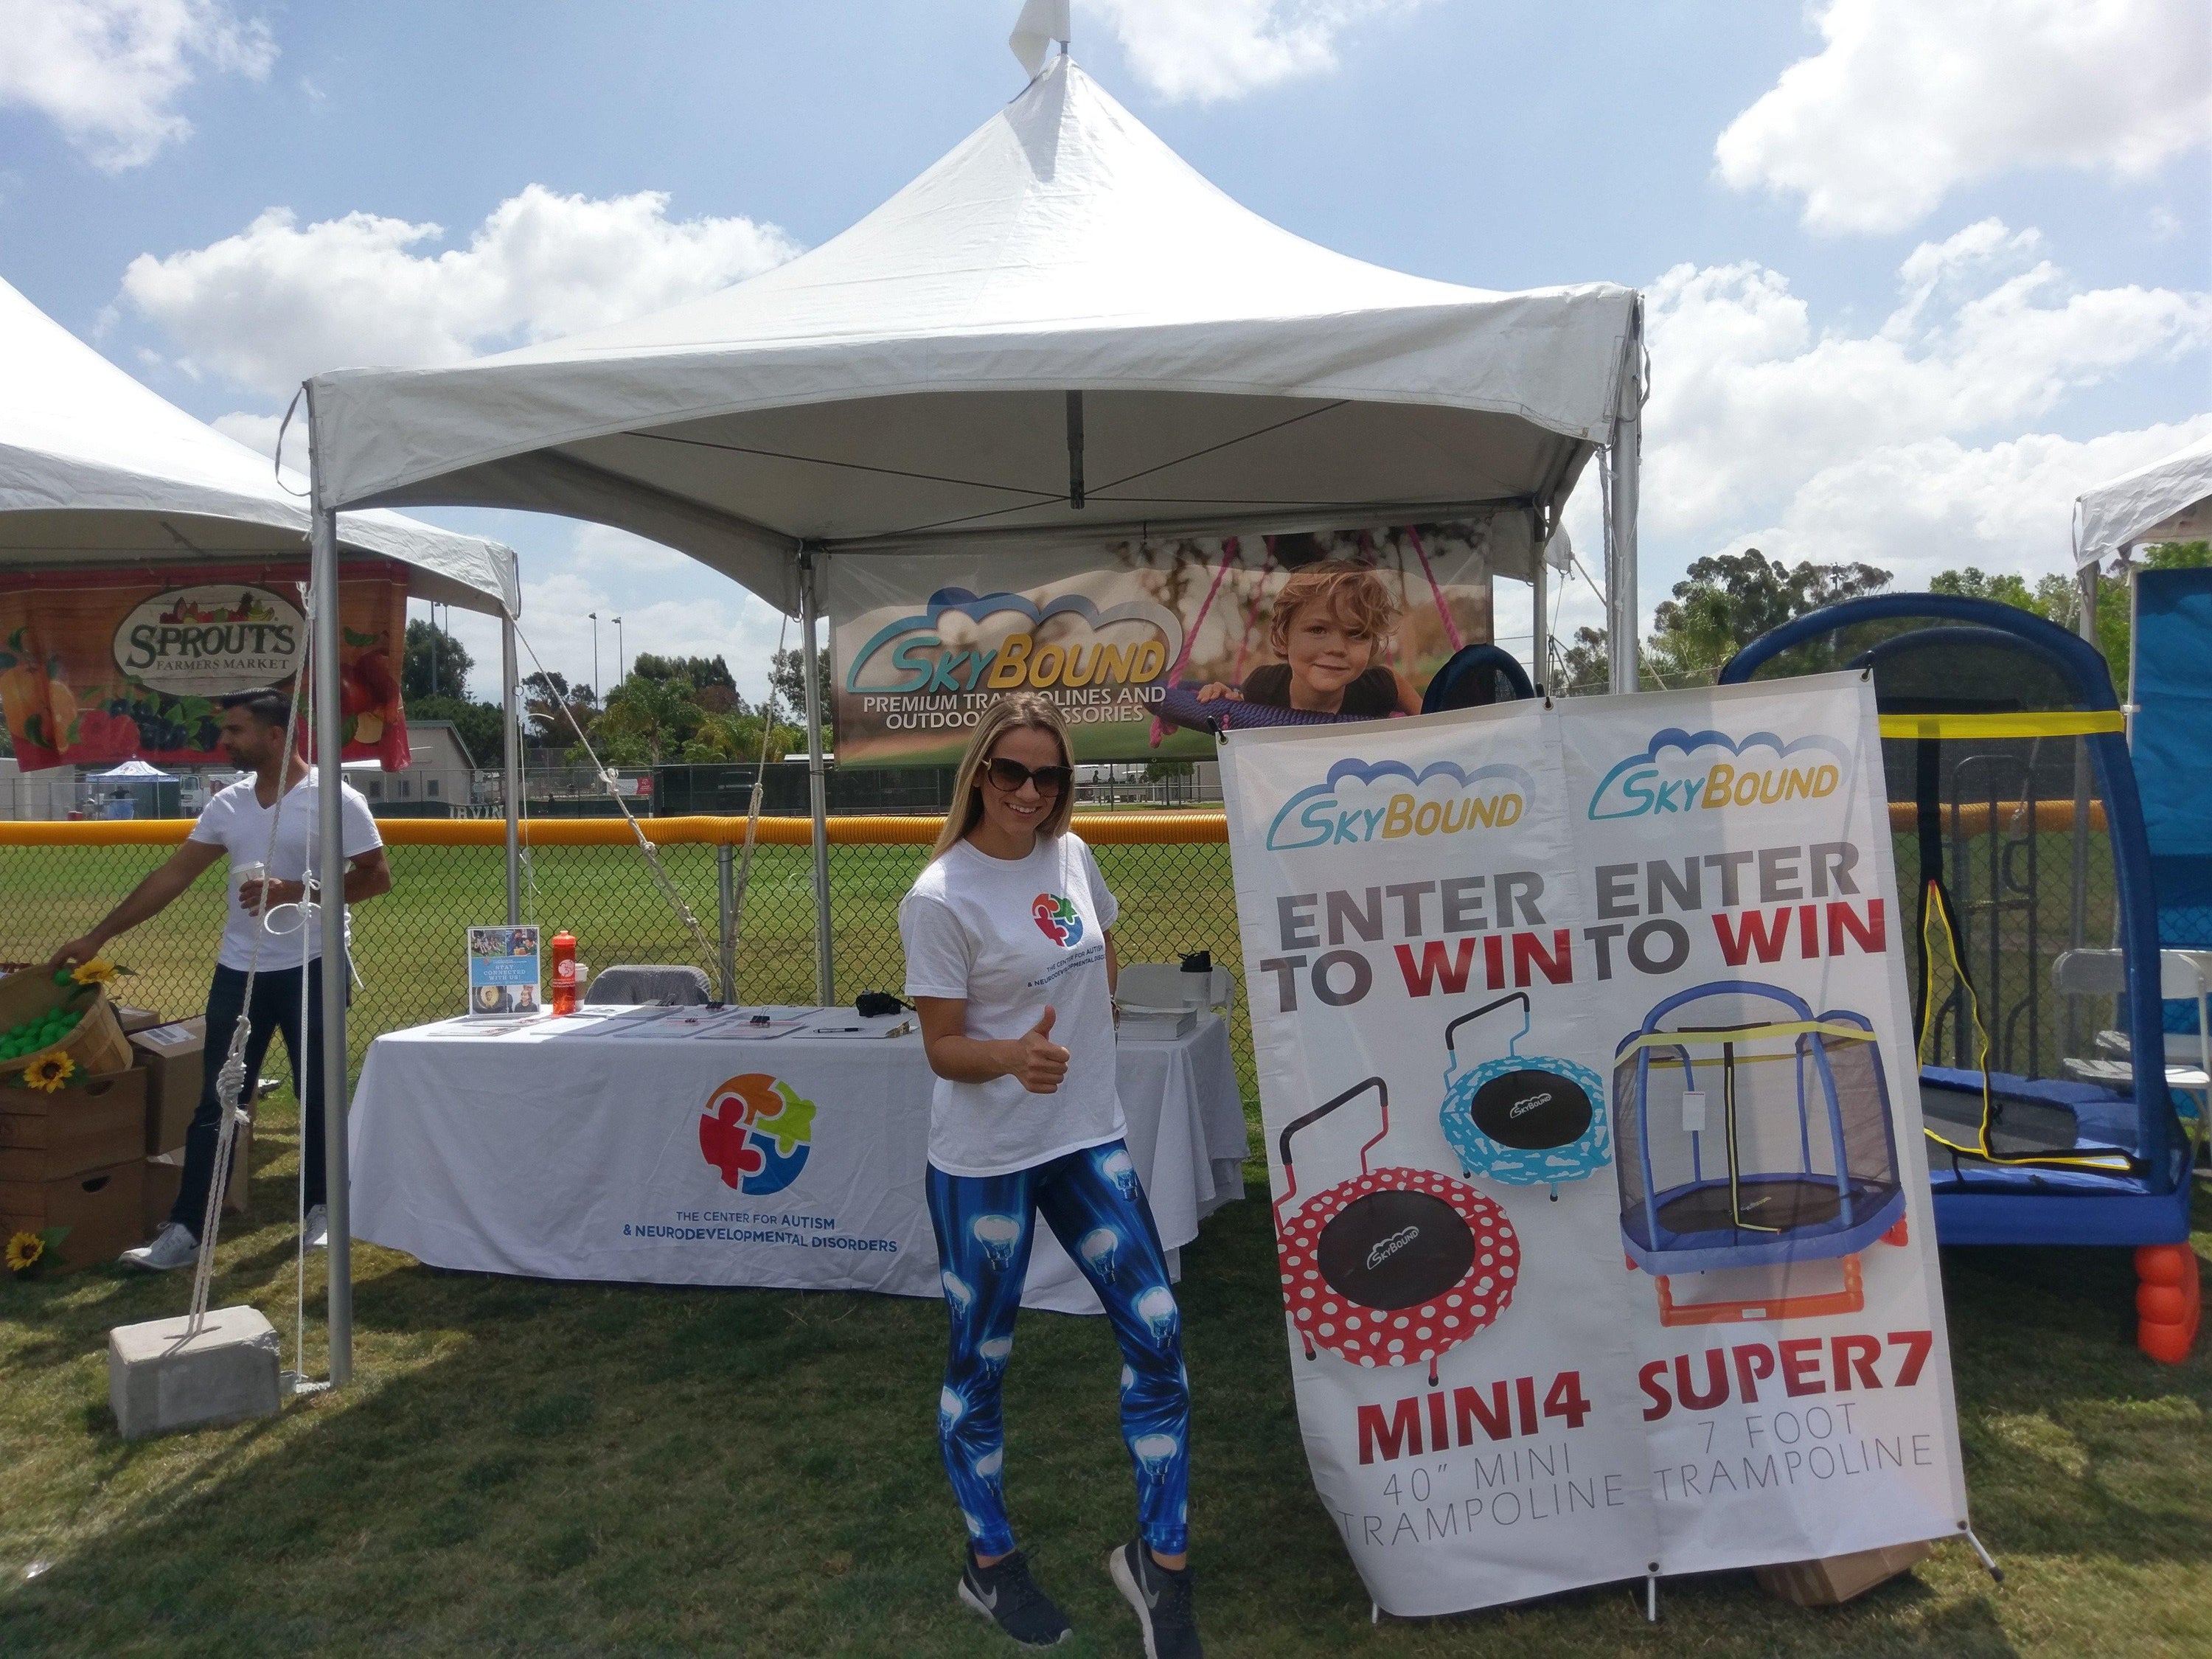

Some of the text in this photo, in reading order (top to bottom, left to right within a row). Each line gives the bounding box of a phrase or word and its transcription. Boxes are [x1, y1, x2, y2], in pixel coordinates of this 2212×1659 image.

[125, 624, 295, 669] SPROUTS
[156, 658, 290, 671] FARMERS MARKET
[863, 686, 1166, 712] PREMIUM TRAOLINES AND
[886, 705, 1144, 729] OUTDOO SSORIES
[449, 804, 504, 819] IRVIN
[1595, 841, 1860, 920] ENTER
[1276, 871, 1547, 950] ENTER
[1584, 898, 1886, 981] TO WIN
[1046, 964, 1056, 972] THE
[1260, 928, 1573, 1013] TO WIN
[623, 1224, 897, 1253] & NEURODEVELOPMENTAL DISORDERS
[676, 1211, 835, 1230] THE CENTER FOR AUTISM
[1638, 1330, 1933, 1422] SUPER7
[1357, 1371, 1591, 1465] MINI4
[1697, 1402, 1856, 1453] 7 FOOT
[1475, 1442, 1569, 1490] MINI
[1654, 1434, 1932, 1501] TRAMPOLINE
[1337, 1474, 1624, 1546] TRAMPOLINE
